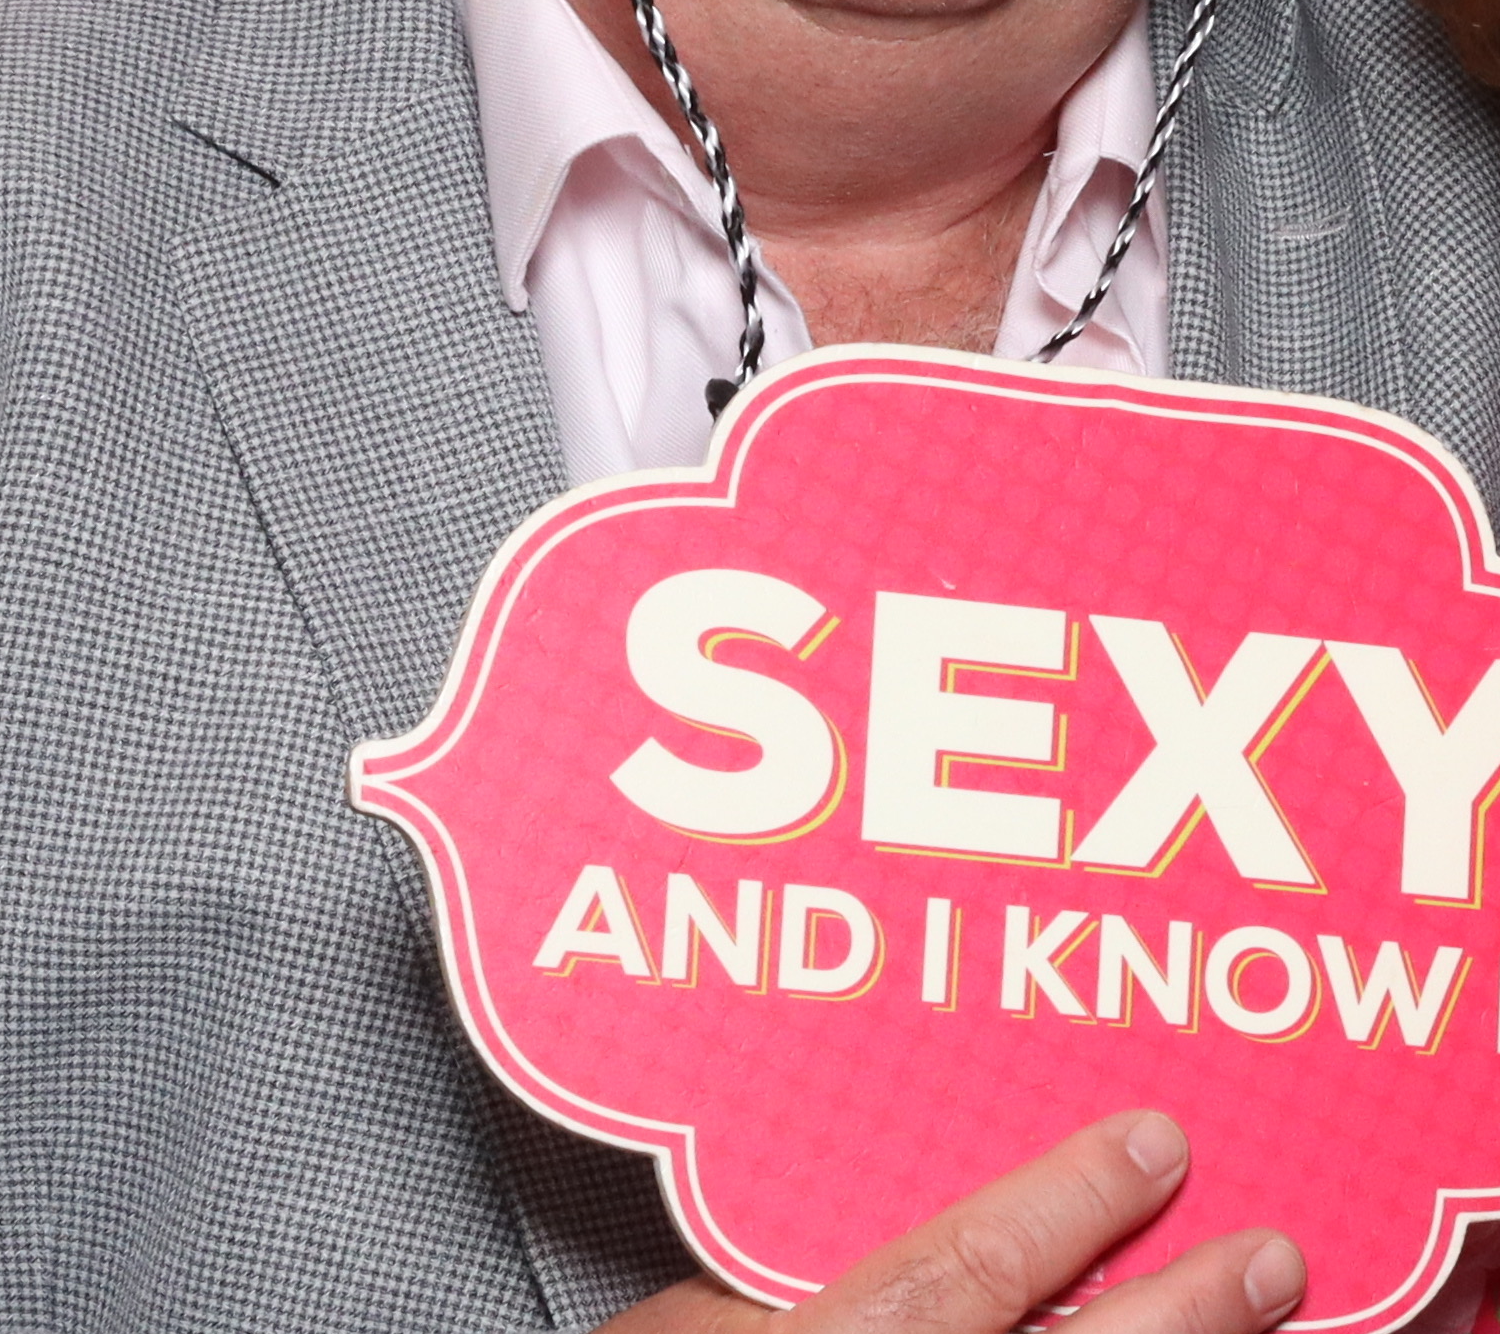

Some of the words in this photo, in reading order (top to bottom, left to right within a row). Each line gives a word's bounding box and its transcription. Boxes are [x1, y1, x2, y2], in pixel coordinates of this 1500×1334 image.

[533, 864, 884, 999] AND
[920, 898, 960, 1010] I
[998, 908, 1470, 1053] KNOW
